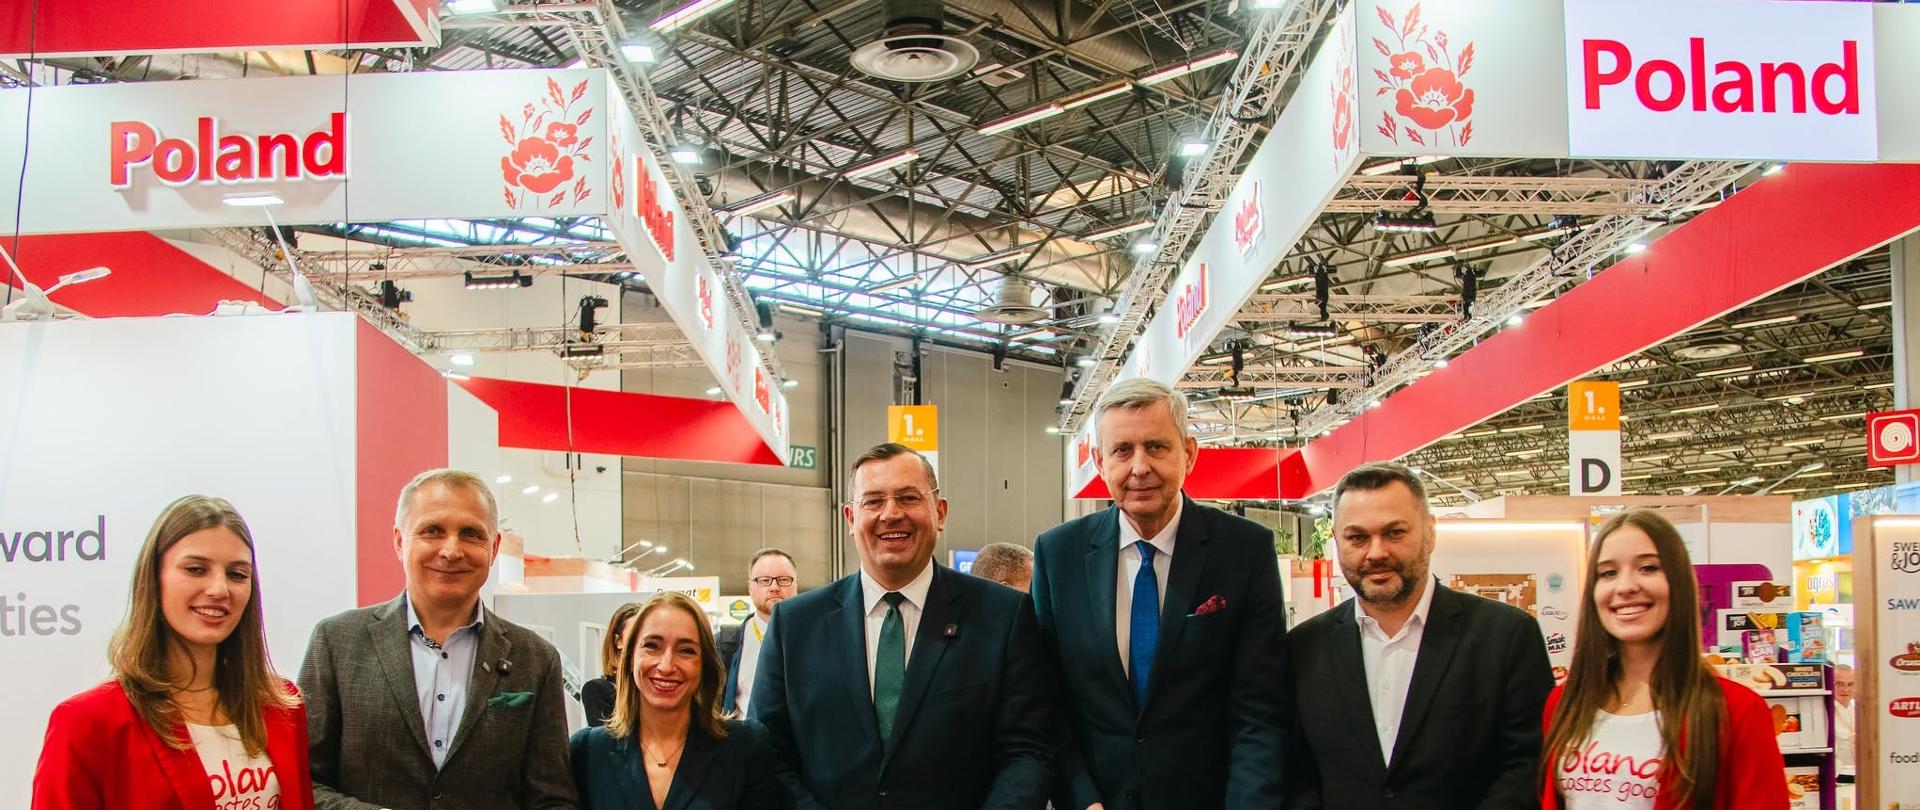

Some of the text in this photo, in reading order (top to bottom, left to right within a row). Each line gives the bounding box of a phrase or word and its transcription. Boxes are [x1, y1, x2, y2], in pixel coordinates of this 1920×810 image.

[1583, 38, 1860, 115] Poland
[110, 112, 346, 186] Poland
[1584, 391, 1605, 414] 1.
[903, 414, 924, 436] 1.
[1581, 459, 1611, 492] D
[1888, 599, 1920, 610] SAW
